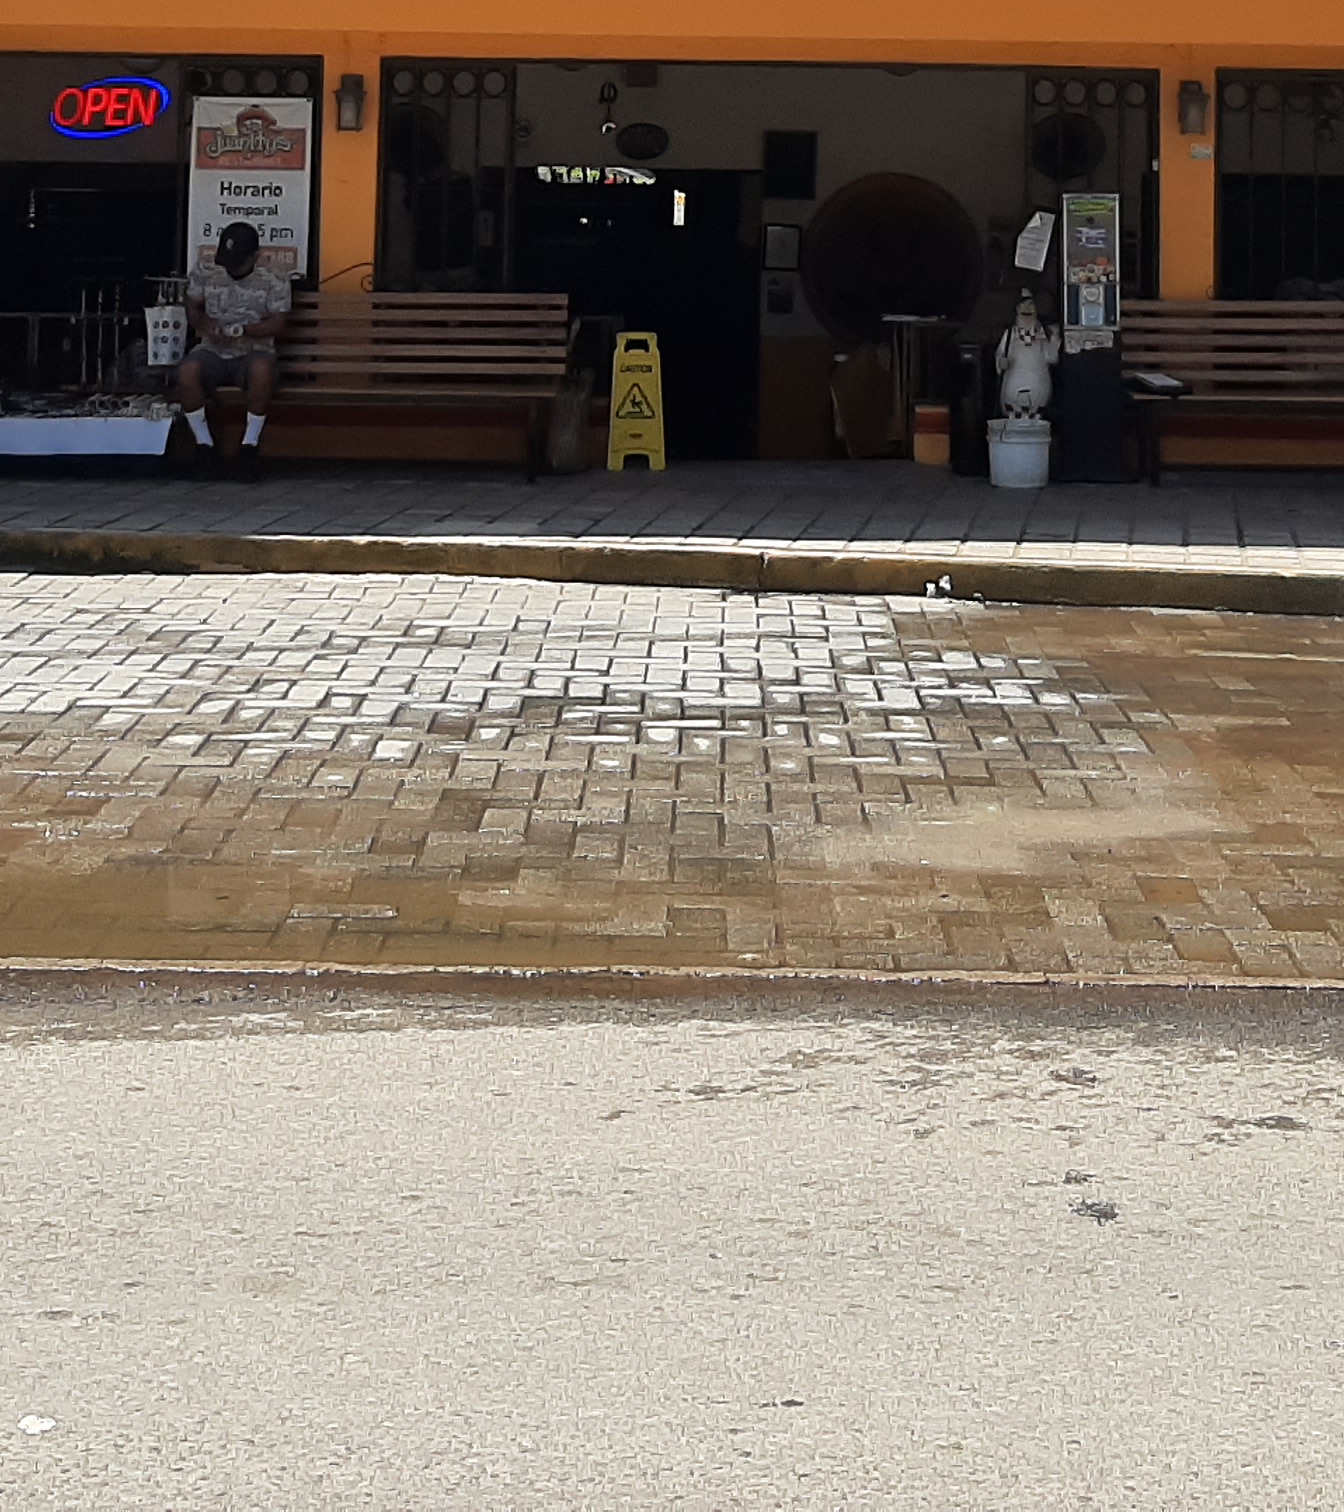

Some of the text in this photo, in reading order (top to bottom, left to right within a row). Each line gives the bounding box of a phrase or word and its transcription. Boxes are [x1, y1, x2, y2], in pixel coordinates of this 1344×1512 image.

[55, 88, 159, 127] OPEN
[220, 180, 283, 198] Horario
[219, 203, 278, 216] Temporal
[270, 227, 294, 242] pm
